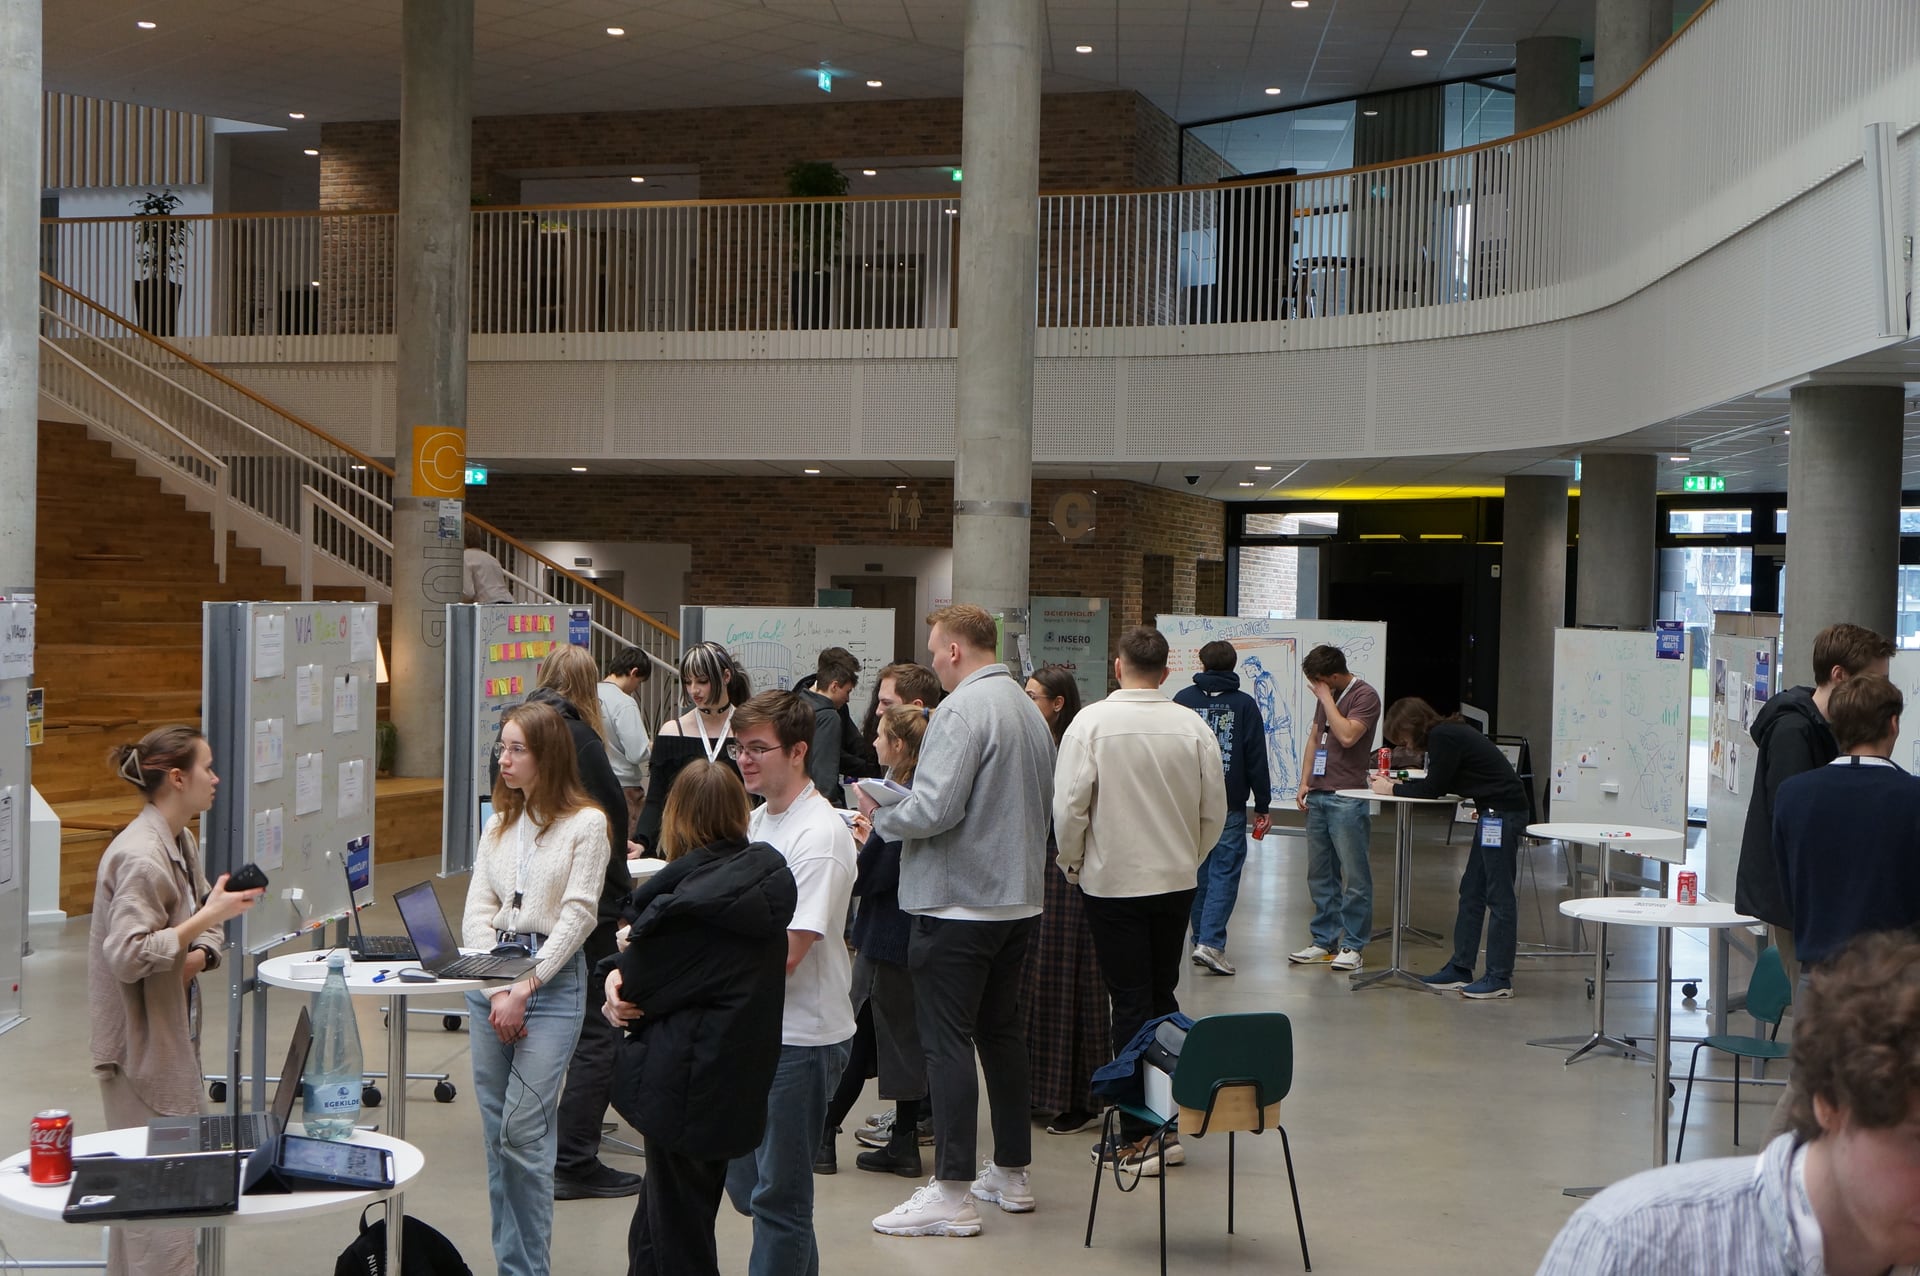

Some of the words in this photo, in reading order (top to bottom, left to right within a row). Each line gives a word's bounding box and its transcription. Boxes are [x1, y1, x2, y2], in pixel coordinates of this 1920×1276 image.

[419, 432, 465, 493] C
[1053, 492, 1091, 539] C
[726, 623, 754, 645] Campus
[1179, 618, 1213, 635] LOOK
[1217, 620, 1269, 640] CHANGE
[1058, 635, 1091, 644] INSERO
[324, 1099, 360, 1108] EGEKILDE
